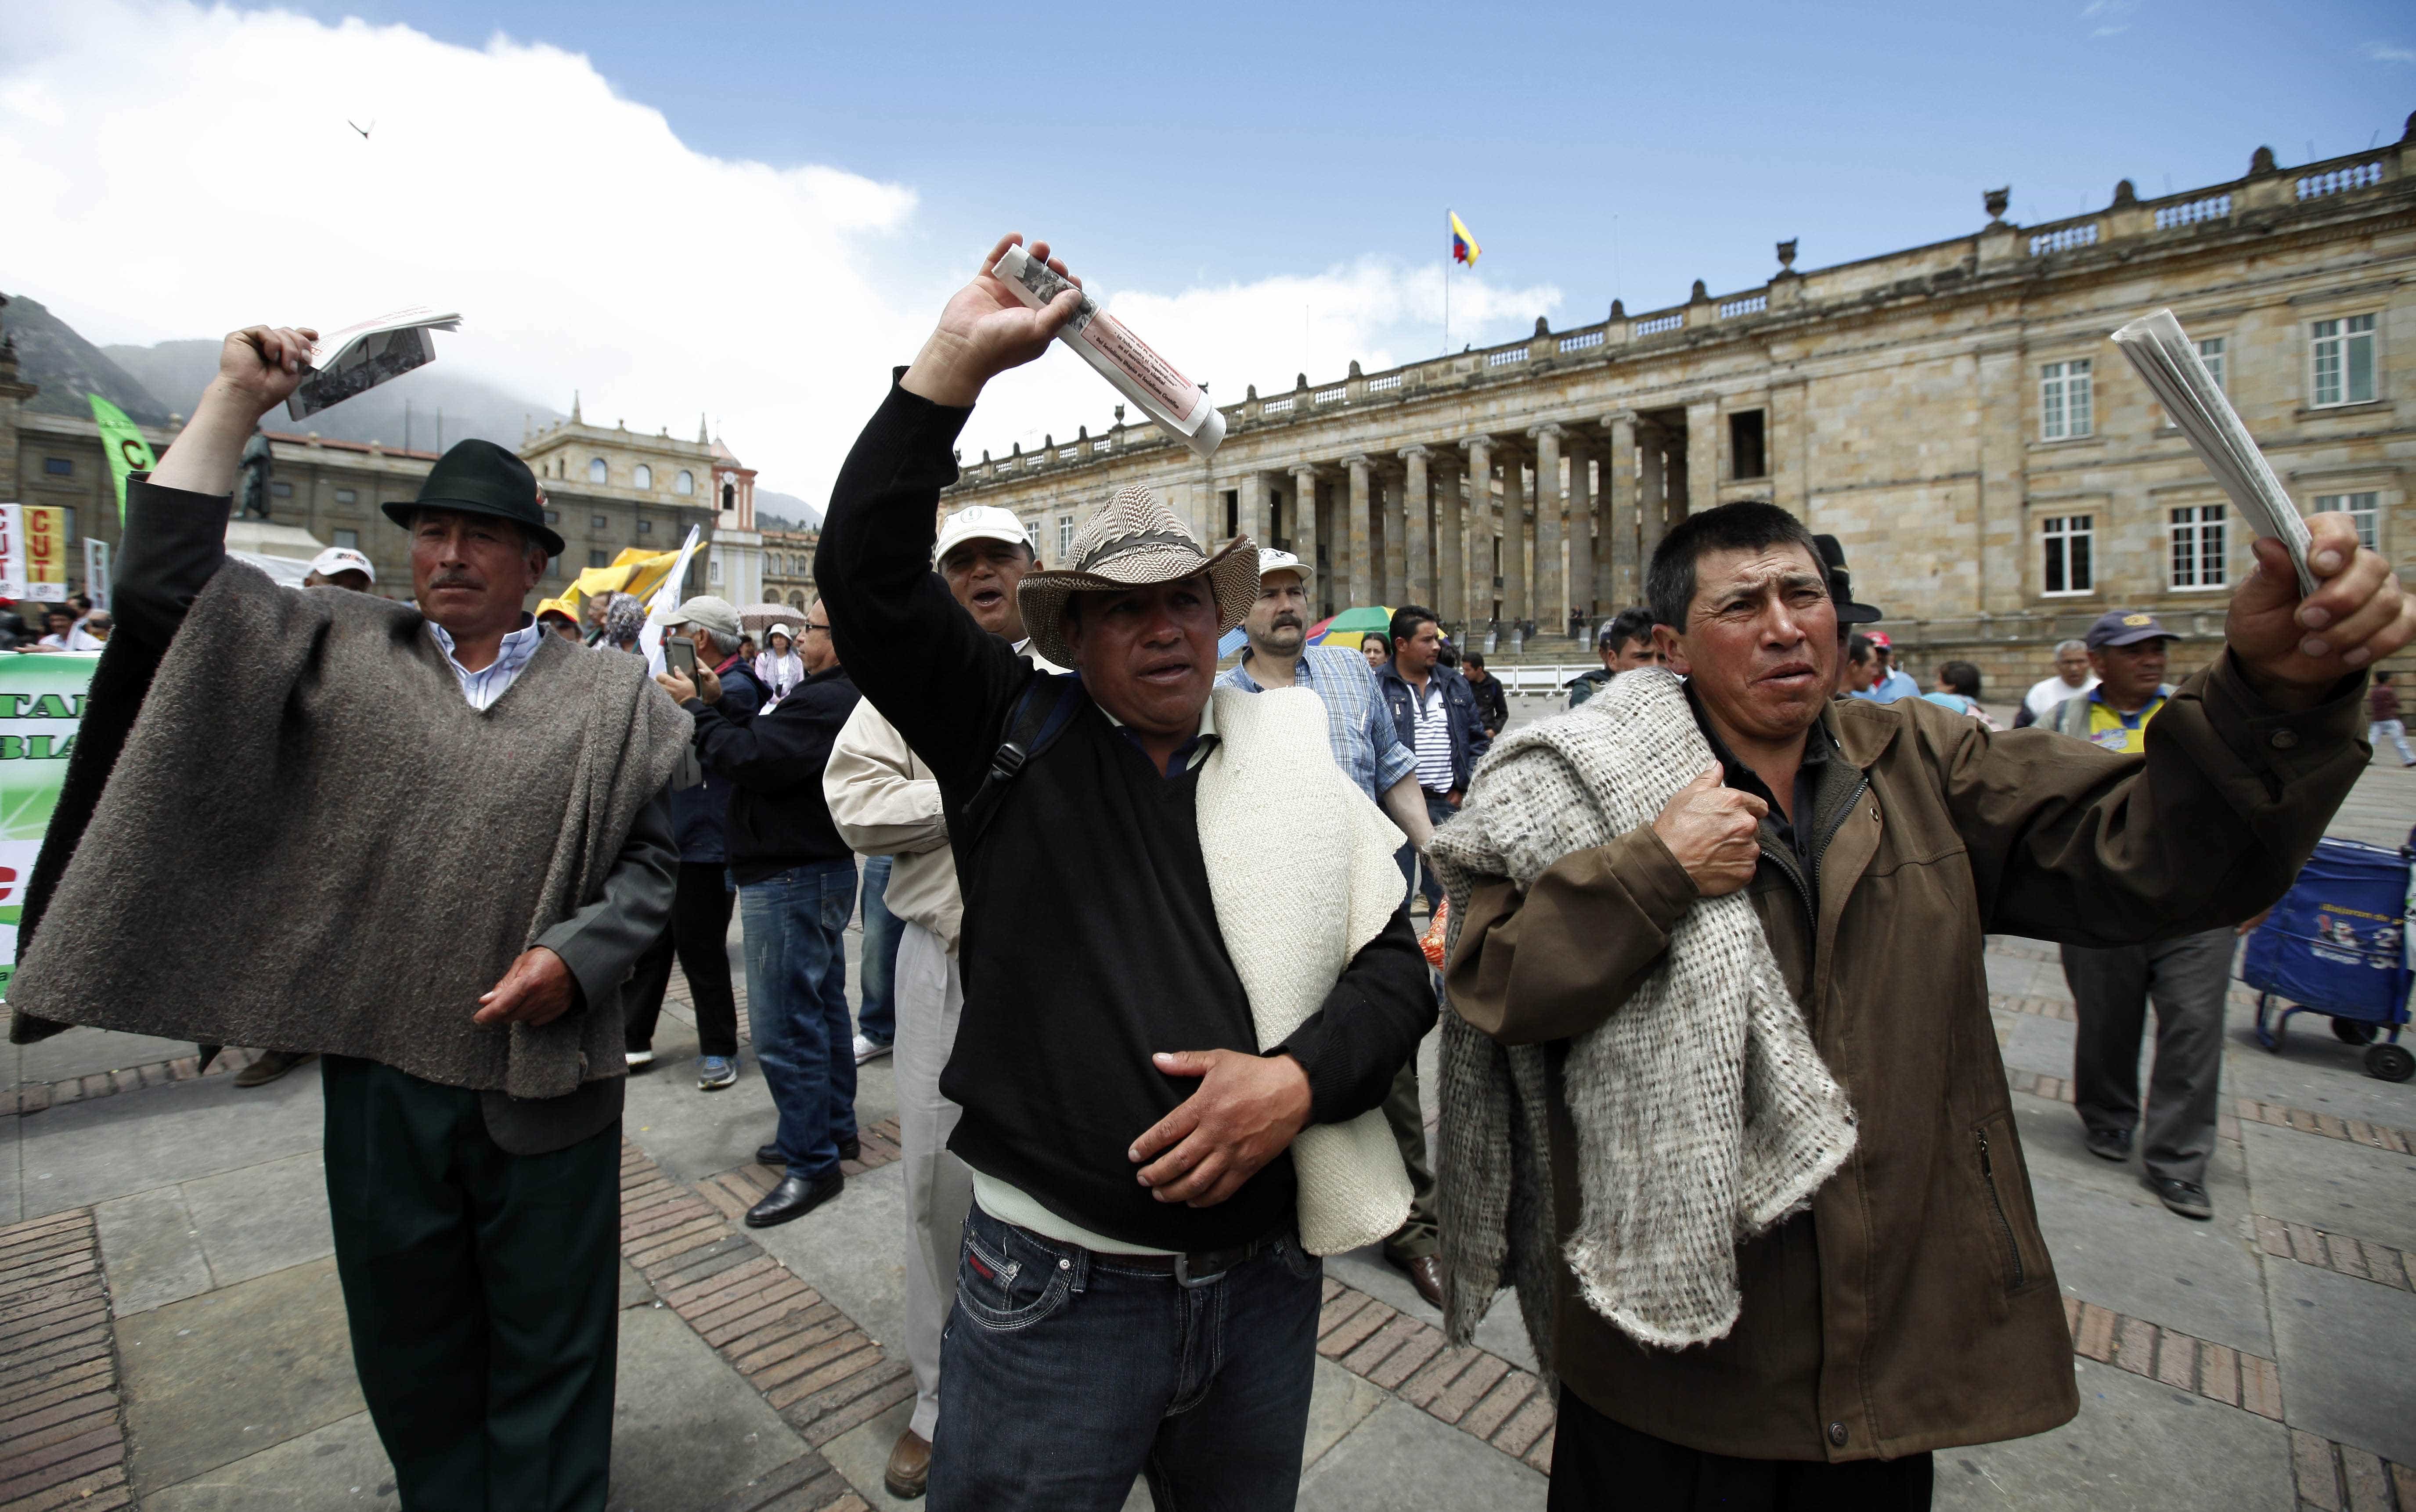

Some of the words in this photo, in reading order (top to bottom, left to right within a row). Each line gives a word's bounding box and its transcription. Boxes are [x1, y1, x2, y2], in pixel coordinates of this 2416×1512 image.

[1095, 336, 1104, 345] Del
[1102, 342, 1124, 362] Socialismo
[1141, 375, 1163, 395] Socialismo
[1121, 338, 1133, 349] lucha
[1132, 347, 1145, 360] contra
[1127, 352, 1151, 373] movimiento
[1150, 371, 1166, 385] sindical
[31, 510, 50, 582] CUT
